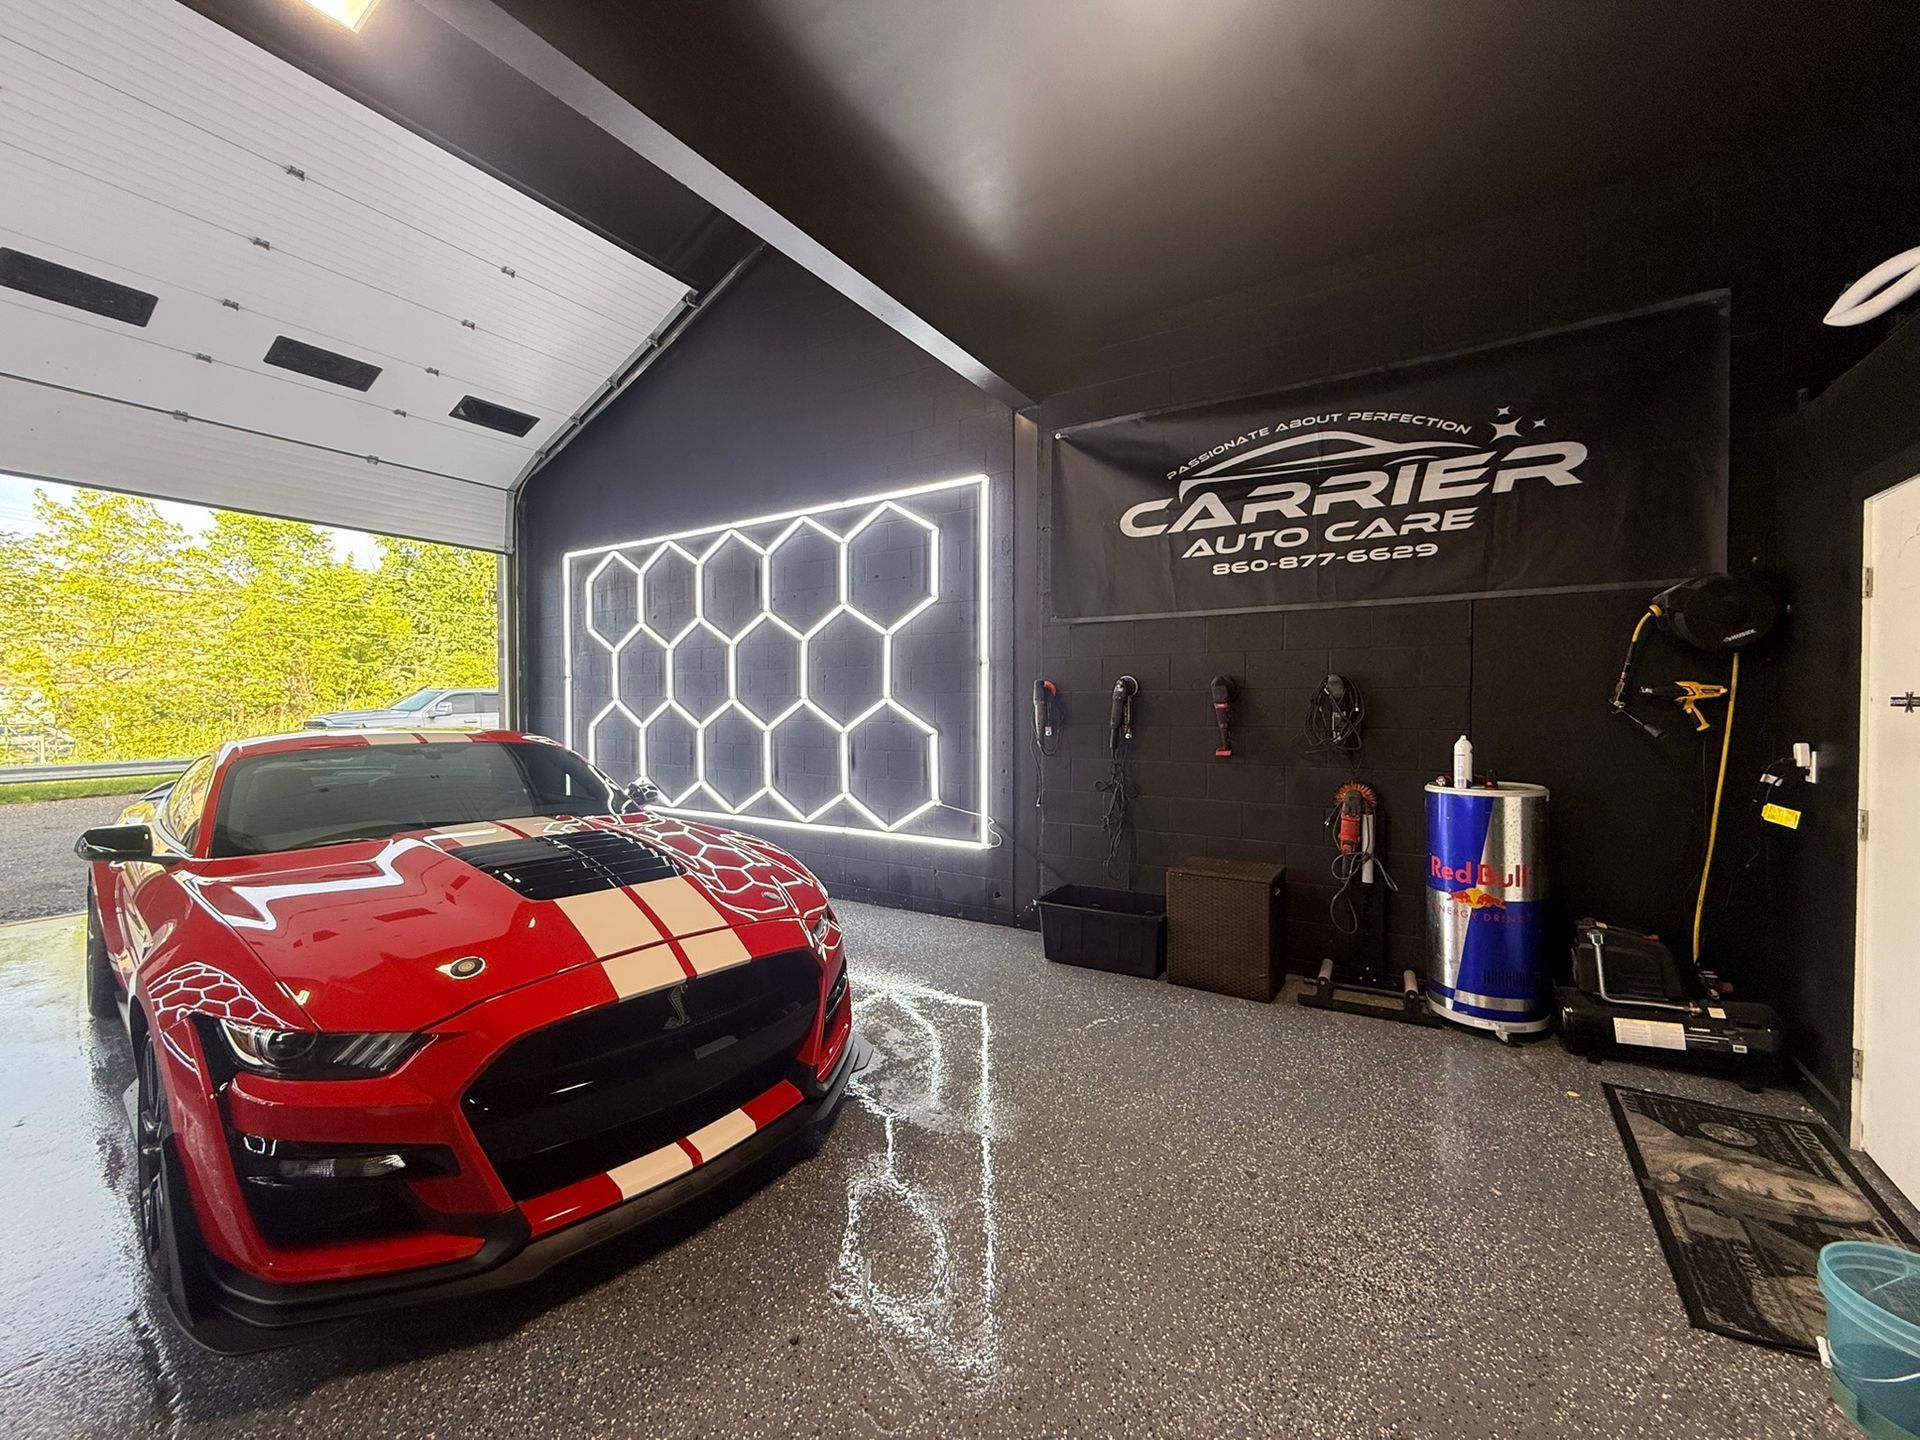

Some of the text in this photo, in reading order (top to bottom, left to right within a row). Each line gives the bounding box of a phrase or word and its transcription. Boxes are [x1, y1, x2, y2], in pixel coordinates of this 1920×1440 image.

[1166, 411, 1473, 481] PASSIONATE ABOUT PERFECTION
[1119, 441, 1588, 538] CARRIER
[1181, 506, 1480, 560] AUTO CARE
[1212, 543, 1439, 576] 860-877-6629
[1430, 855, 1530, 888] Red Bull
